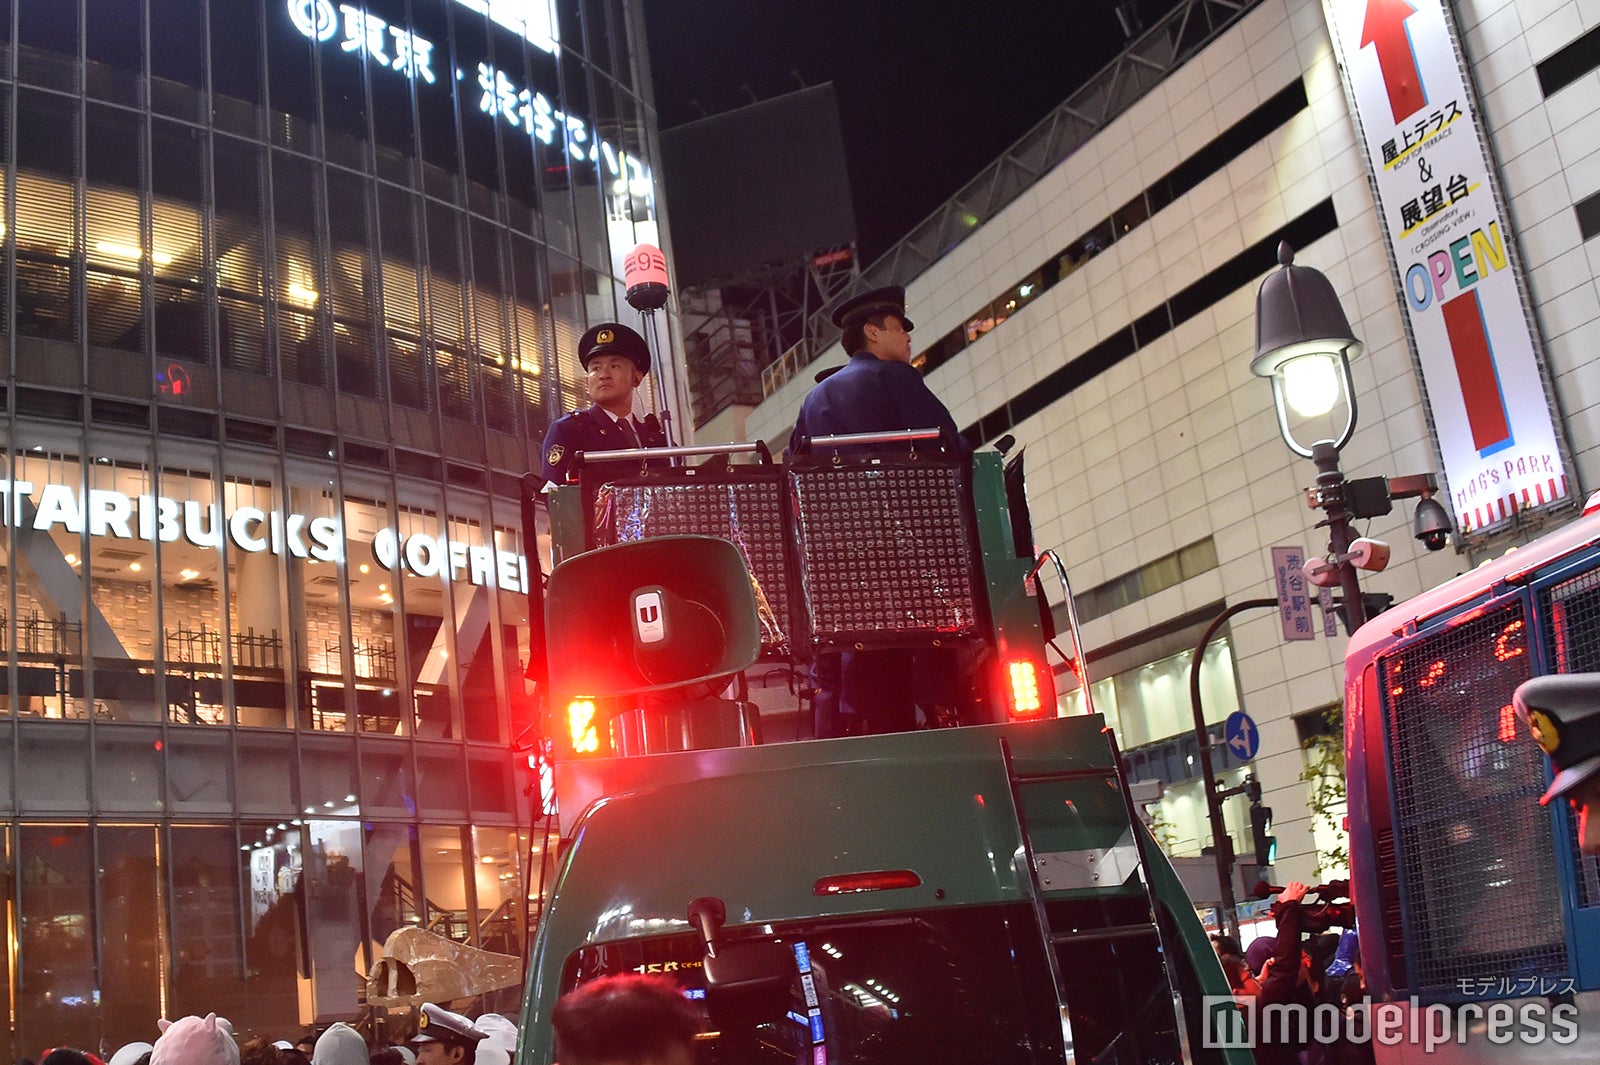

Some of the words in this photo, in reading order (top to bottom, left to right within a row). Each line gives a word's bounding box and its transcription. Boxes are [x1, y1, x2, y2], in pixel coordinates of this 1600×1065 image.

[1381, 100, 1463, 165] 屋上テラス
[1423, 127, 1453, 151] TERRACE
[1418, 156, 1434, 183] &
[1400, 174, 1470, 231] 展望台
[1420, 207, 1459, 237] Observatory
[1405, 219, 1508, 312] OPEN
[1503, 454, 1554, 480] PARK
